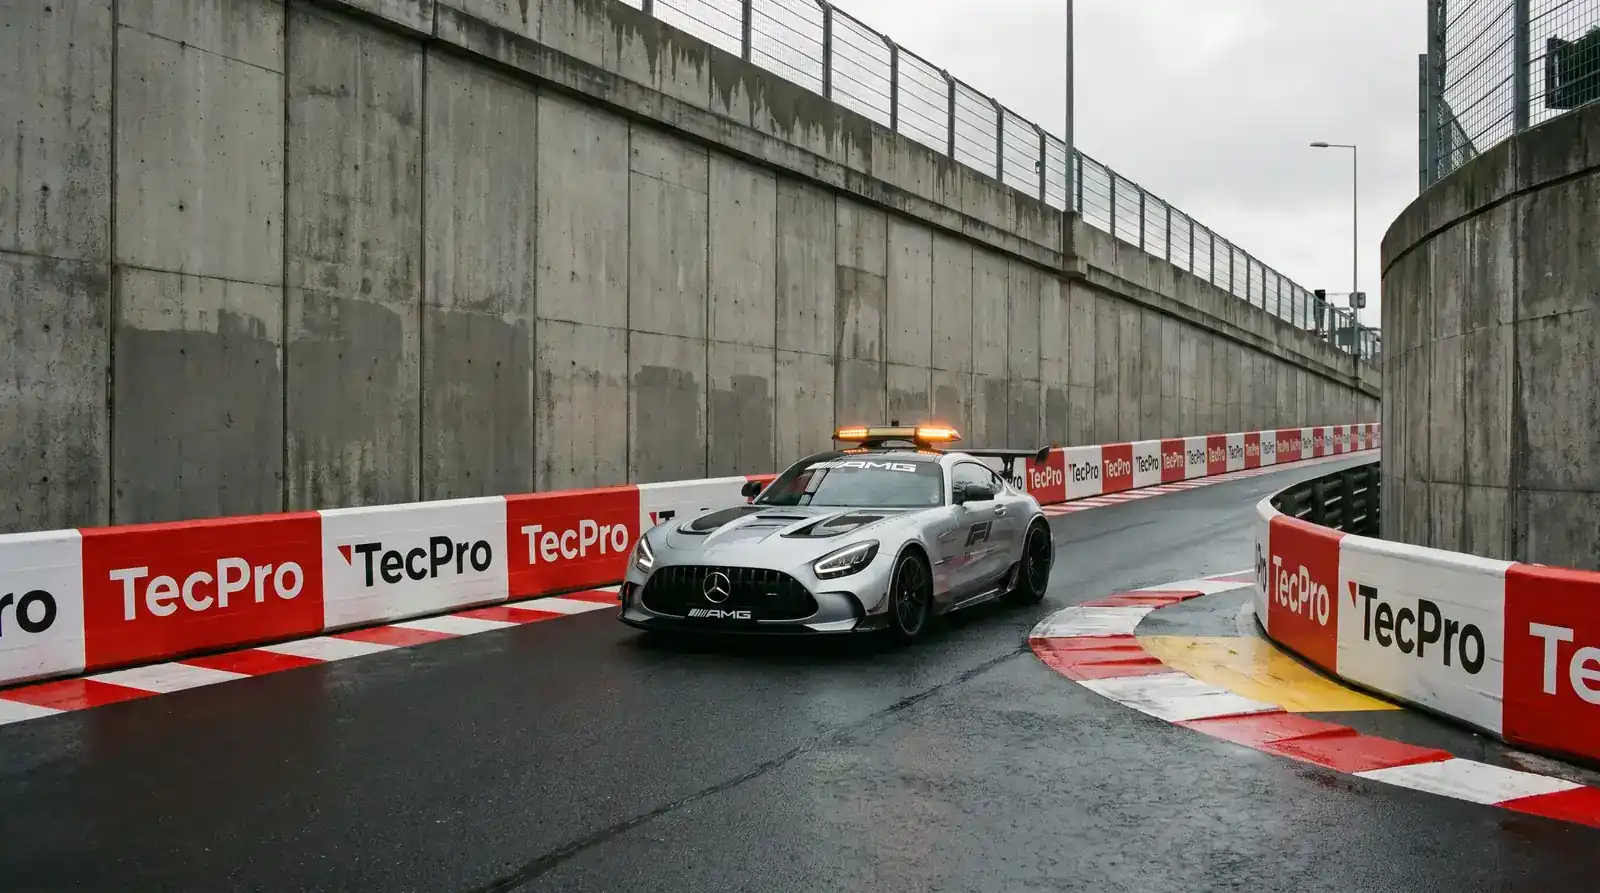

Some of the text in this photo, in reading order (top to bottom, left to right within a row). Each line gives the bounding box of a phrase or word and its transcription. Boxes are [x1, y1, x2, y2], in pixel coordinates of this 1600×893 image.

[1137, 455, 1158, 472] TecPro
[1162, 452, 1183, 469] TecPro
[1187, 449, 1205, 464] TecPro
[1208, 447, 1225, 463] TecPro
[1029, 466, 1062, 489] TecPro
[1071, 462, 1099, 482] TecPro
[1104, 458, 1131, 478] TecPro
[521, 518, 629, 564] TecPro
[356, 536, 492, 588] TecPro
[109, 557, 304, 621] TecPro
[1272, 554, 1330, 627] TecPro
[1358, 584, 1485, 675] TecPro
